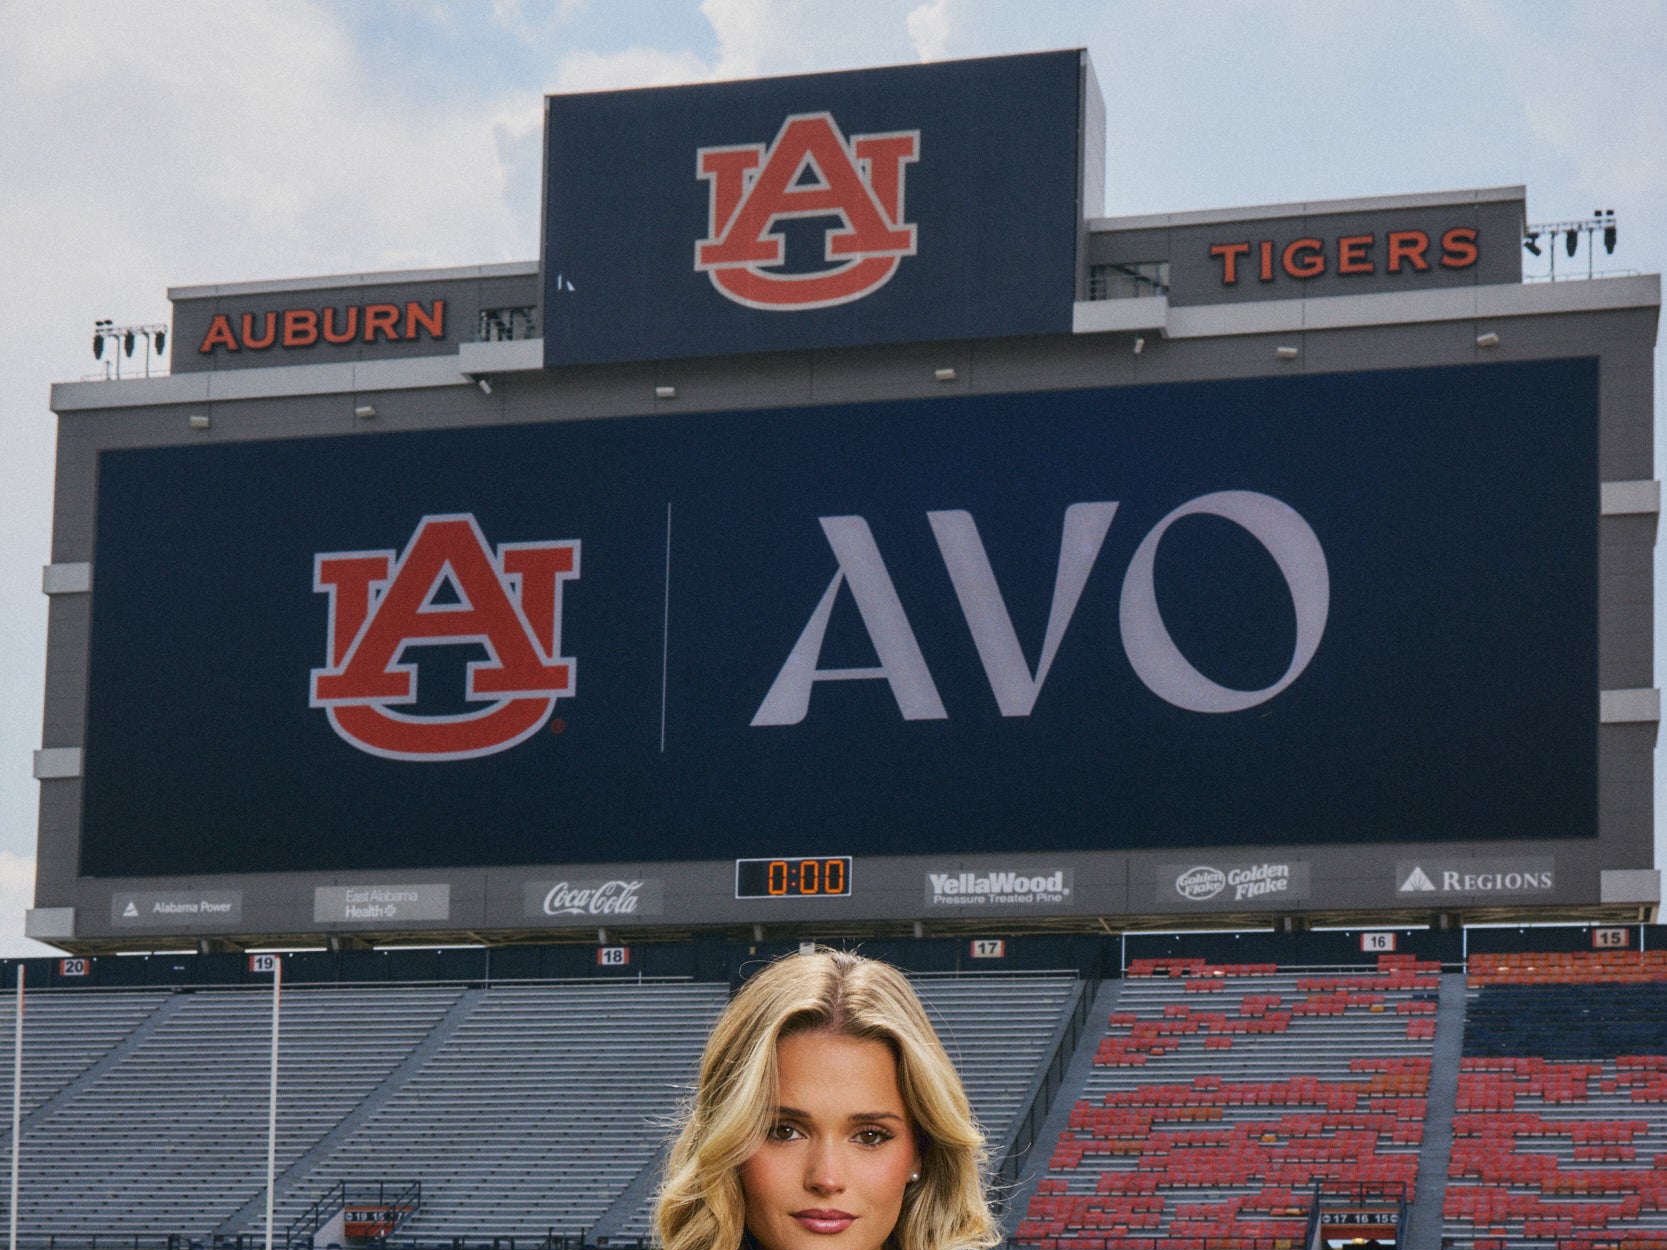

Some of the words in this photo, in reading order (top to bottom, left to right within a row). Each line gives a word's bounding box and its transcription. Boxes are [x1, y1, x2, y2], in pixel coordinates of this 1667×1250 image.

[1210, 228, 1479, 283] TIGERS
[200, 300, 445, 353] AUBURN
[750, 490, 1330, 726] AVO
[768, 859, 844, 895] 0:00
[1227, 864, 1289, 886] Golden
[1442, 871, 1552, 891] REGIONS
[346, 890, 369, 902] East
[371, 889, 417, 901] Alabama
[1235, 878, 1288, 900] Flake
[543, 881, 644, 915] Coca-Cola
[933, 894, 985, 904] Pressure
[988, 893, 1033, 903] Treated
[1036, 892, 1062, 902] Pine
[153, 902, 198, 913] Alabama
[200, 900, 232, 912] Power
[346, 905, 383, 918] Health
[1370, 936, 1386, 948] 16
[1600, 932, 1621, 945] 15
[978, 942, 998, 955] 17
[255, 957, 274, 969] 19
[603, 950, 622, 963] 18
[65, 960, 84, 973] 20
[355, 1212, 367, 1221] 19
[1333, 1214, 1347, 1223] 17
[1355, 1214, 1369, 1223] 16
[1375, 1214, 1389, 1223] 15
